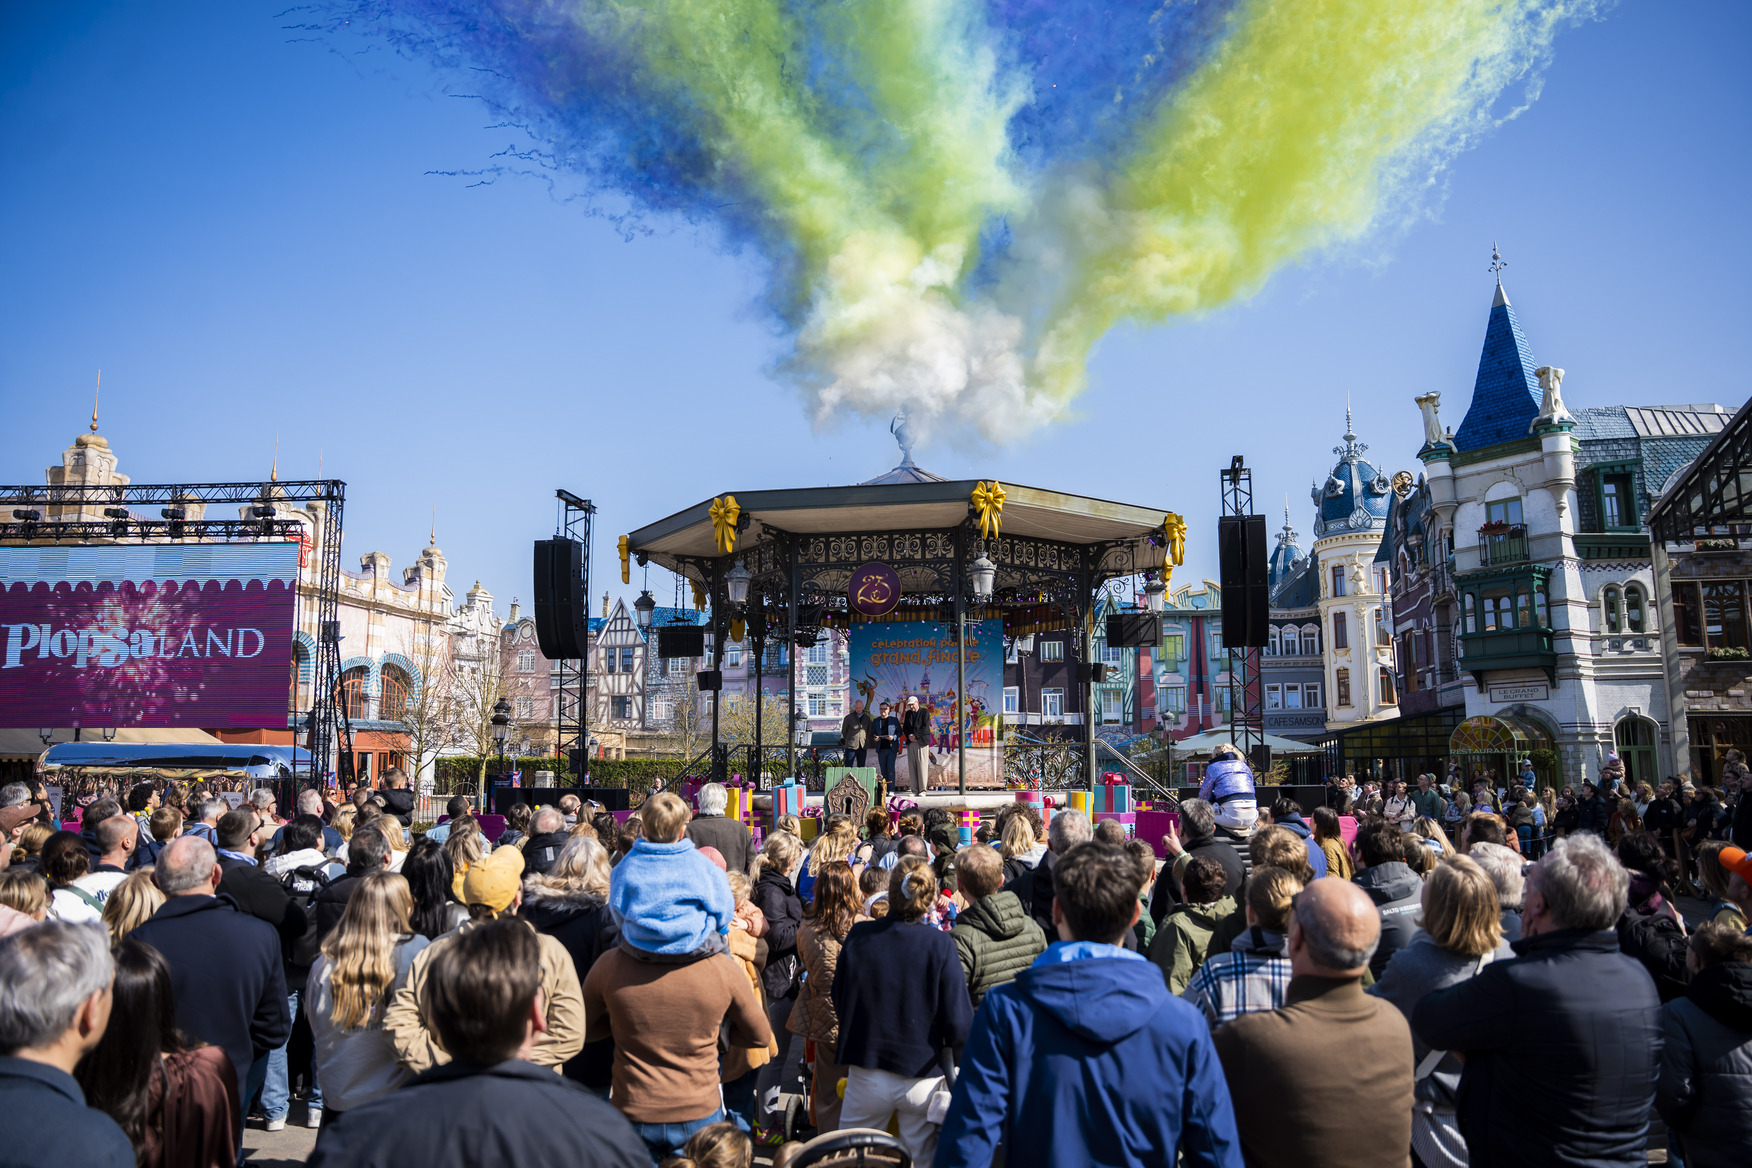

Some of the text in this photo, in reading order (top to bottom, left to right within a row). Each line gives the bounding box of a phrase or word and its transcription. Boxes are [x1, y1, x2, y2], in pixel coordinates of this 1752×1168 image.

[857, 574, 891, 604] 25
[1288, 716, 1325, 726] SAMSON
[1450, 747, 1514, 755] RESTAURANT
